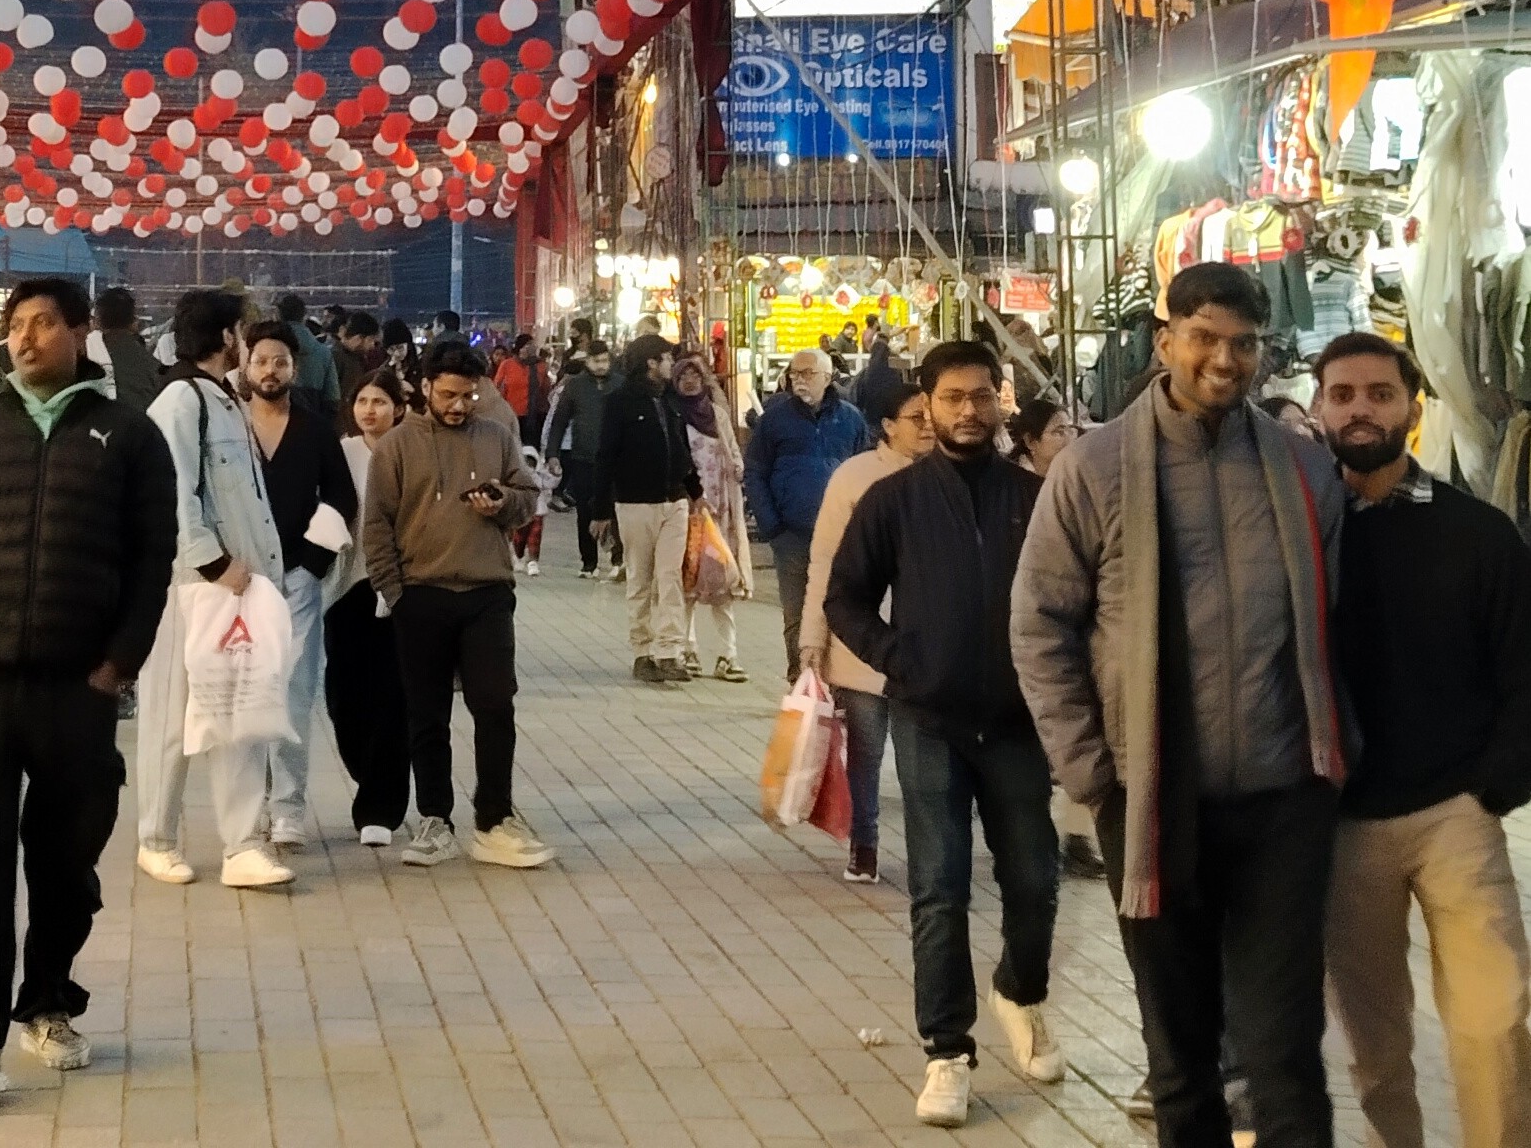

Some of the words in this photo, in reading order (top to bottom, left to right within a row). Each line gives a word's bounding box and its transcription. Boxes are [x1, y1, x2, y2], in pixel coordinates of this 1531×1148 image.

[811, 28, 866, 61] Eye
[875, 29, 948, 54] Care
[794, 98, 820, 118] Eye
